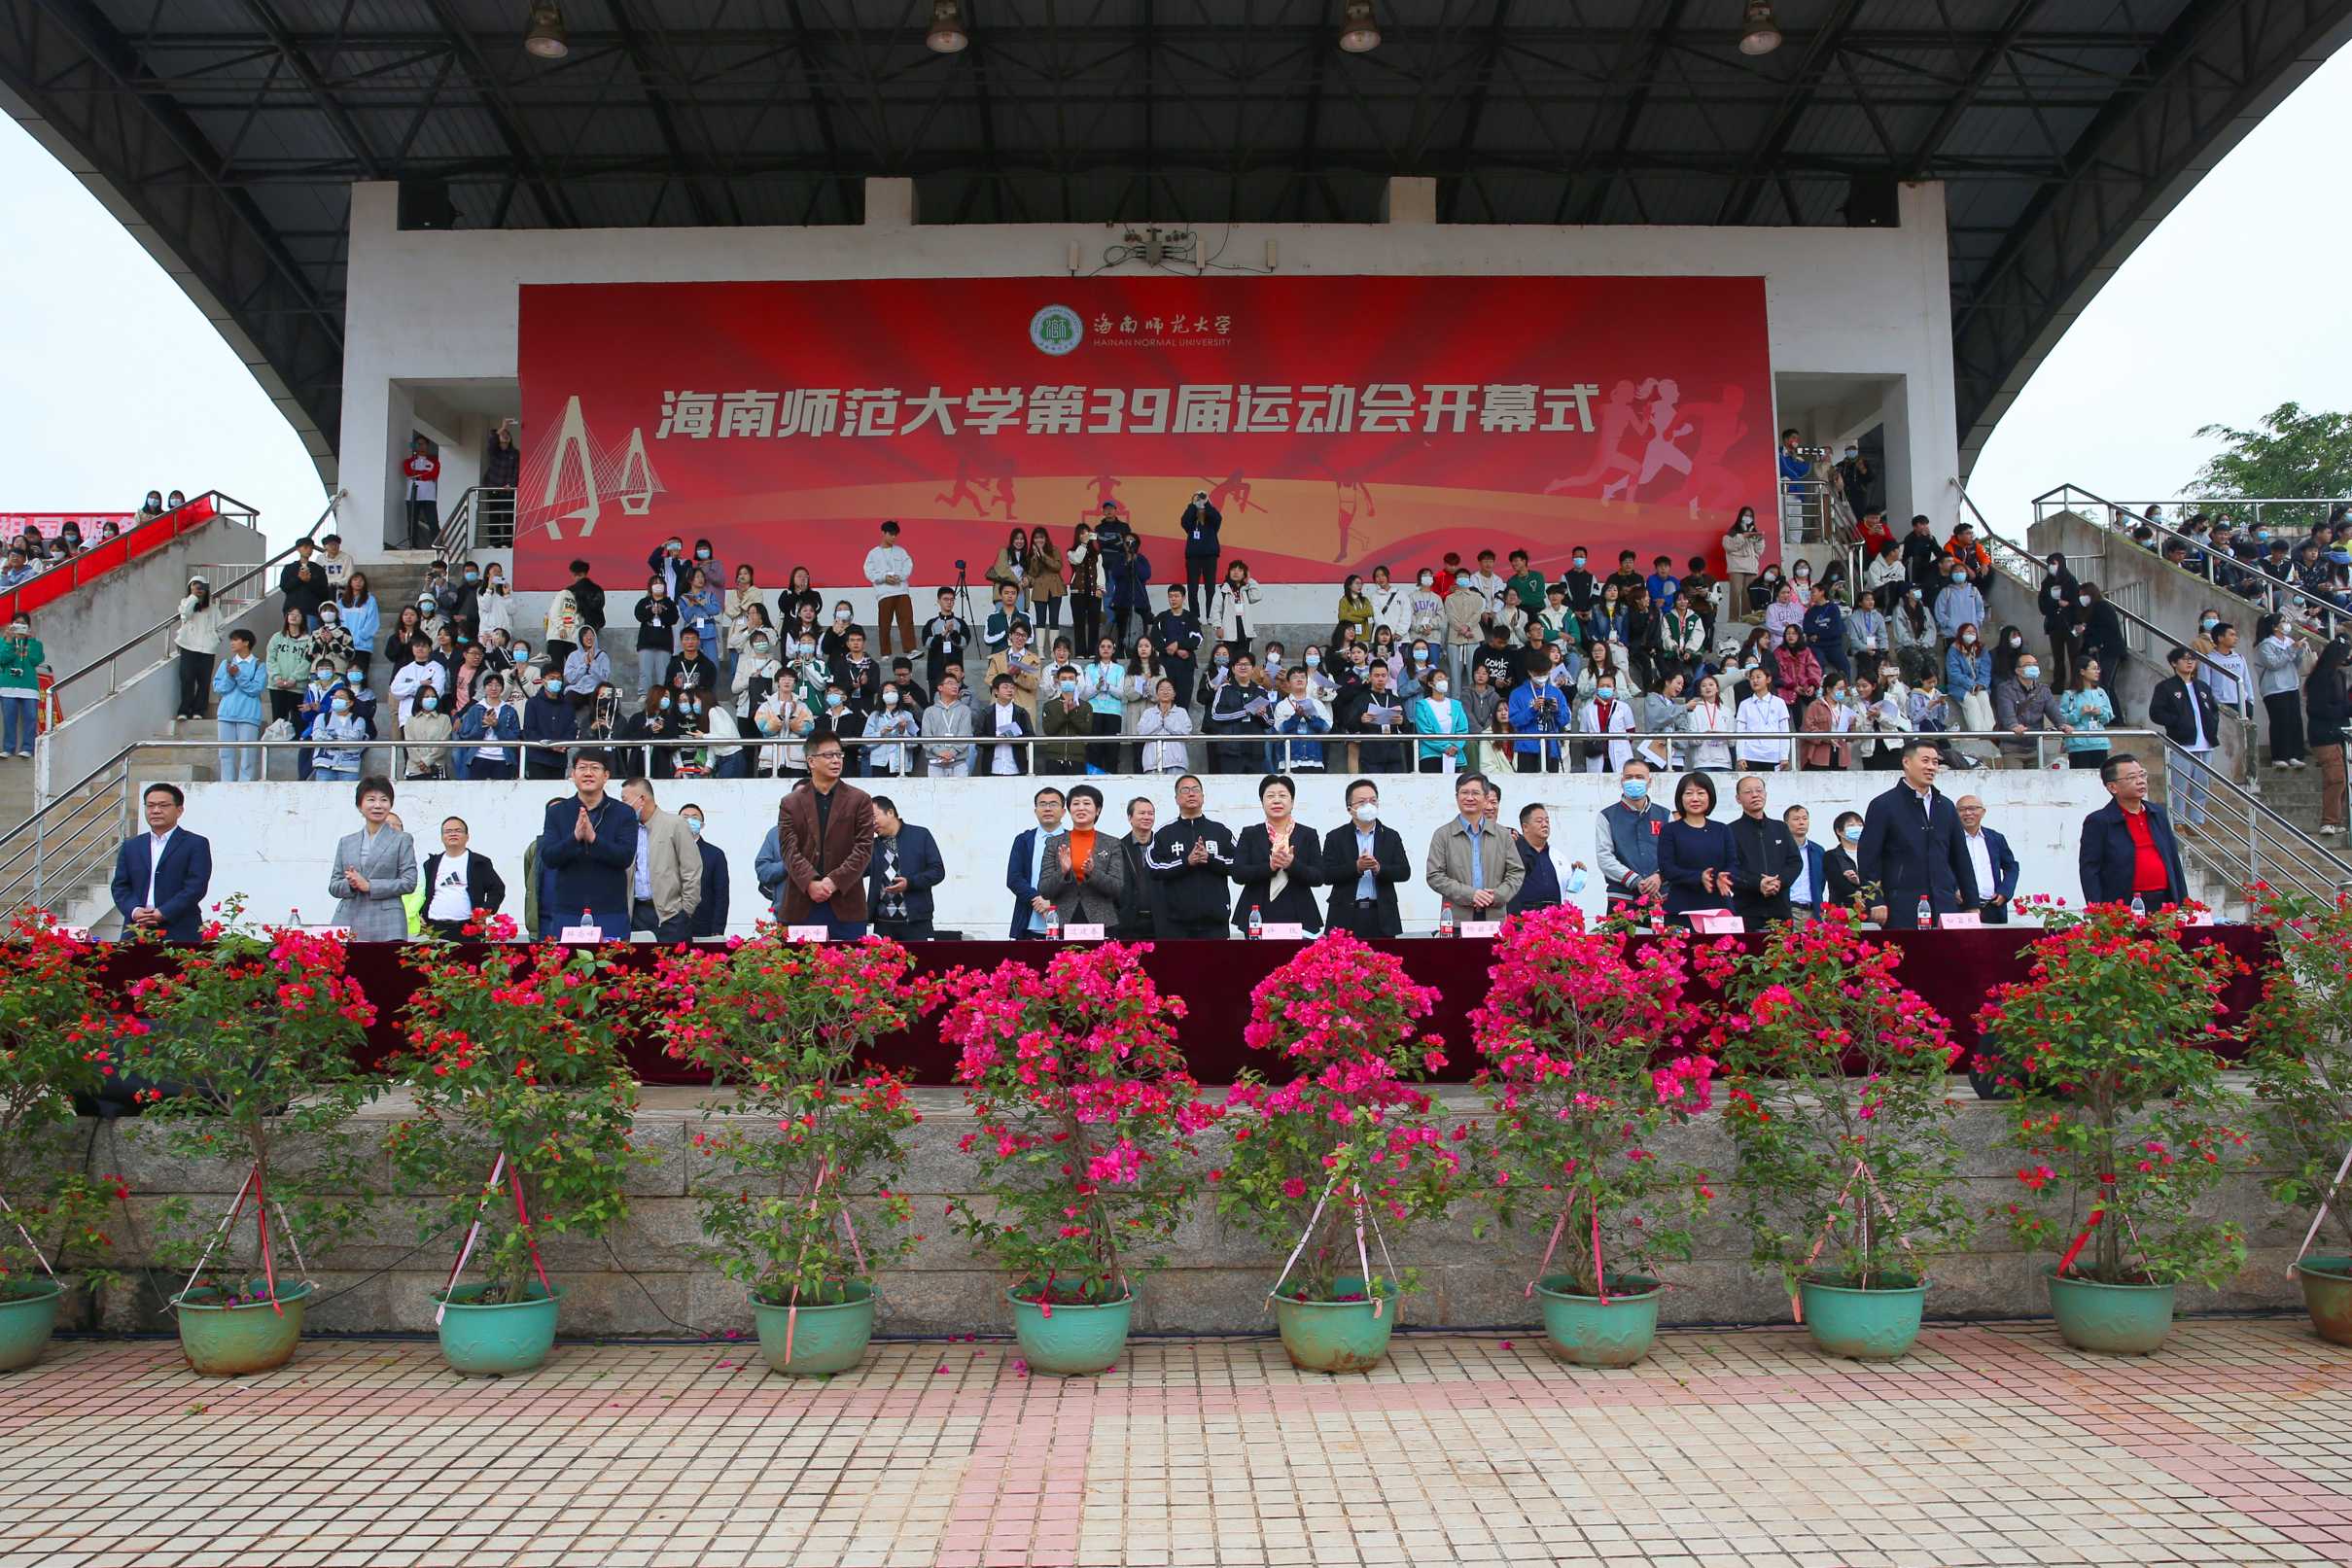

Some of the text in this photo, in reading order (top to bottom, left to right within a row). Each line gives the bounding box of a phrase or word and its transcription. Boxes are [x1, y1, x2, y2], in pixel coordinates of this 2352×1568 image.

[1094, 313, 1232, 335] 海南师范大学
[1093, 337, 1232, 347] HAINAN NORMAL UNIVERSITY
[655, 383, 1599, 439] 海南师范大学第39届运动会开幕式
